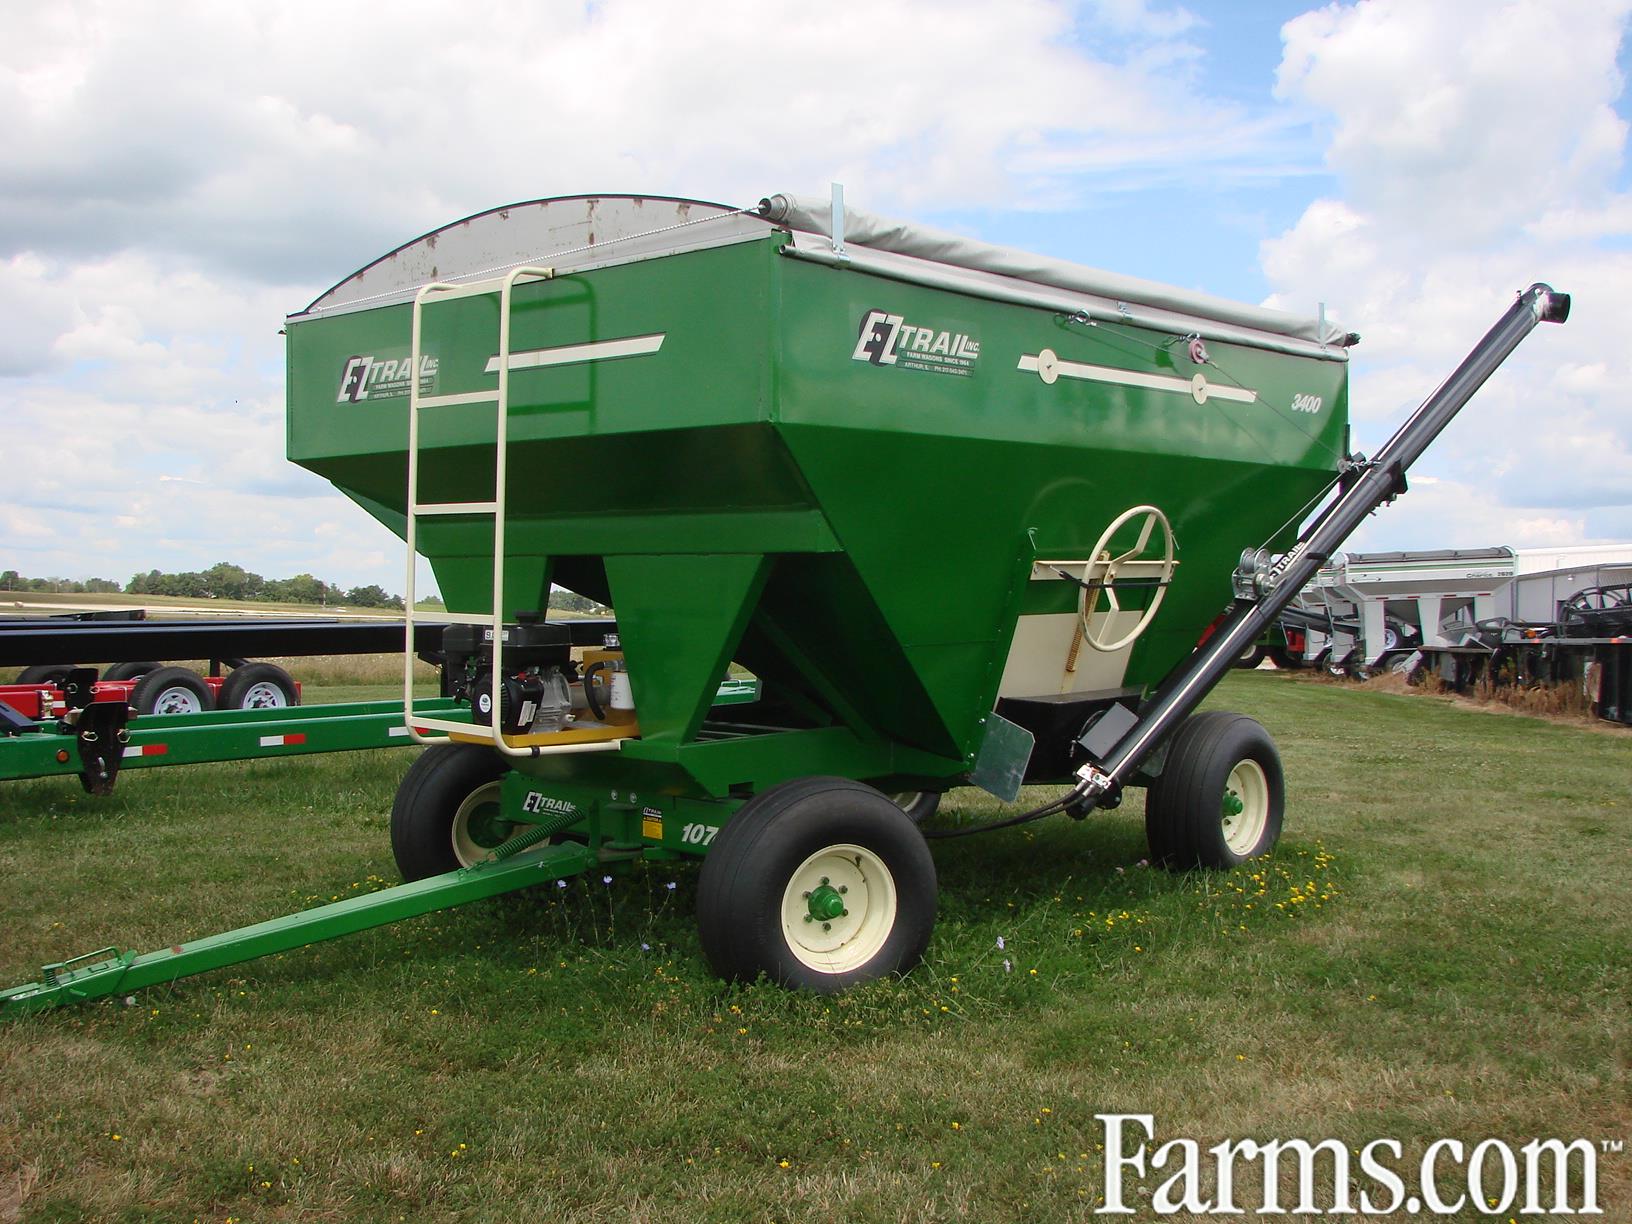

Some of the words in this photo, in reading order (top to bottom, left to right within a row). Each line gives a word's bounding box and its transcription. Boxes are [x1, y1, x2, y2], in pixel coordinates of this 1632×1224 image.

[899, 325, 978, 359] TRAIL
[369, 355, 438, 384] TRAL
[1291, 393, 1322, 414] 3400
[540, 796, 574, 812] TRAIL
[681, 822, 719, 846] 107
